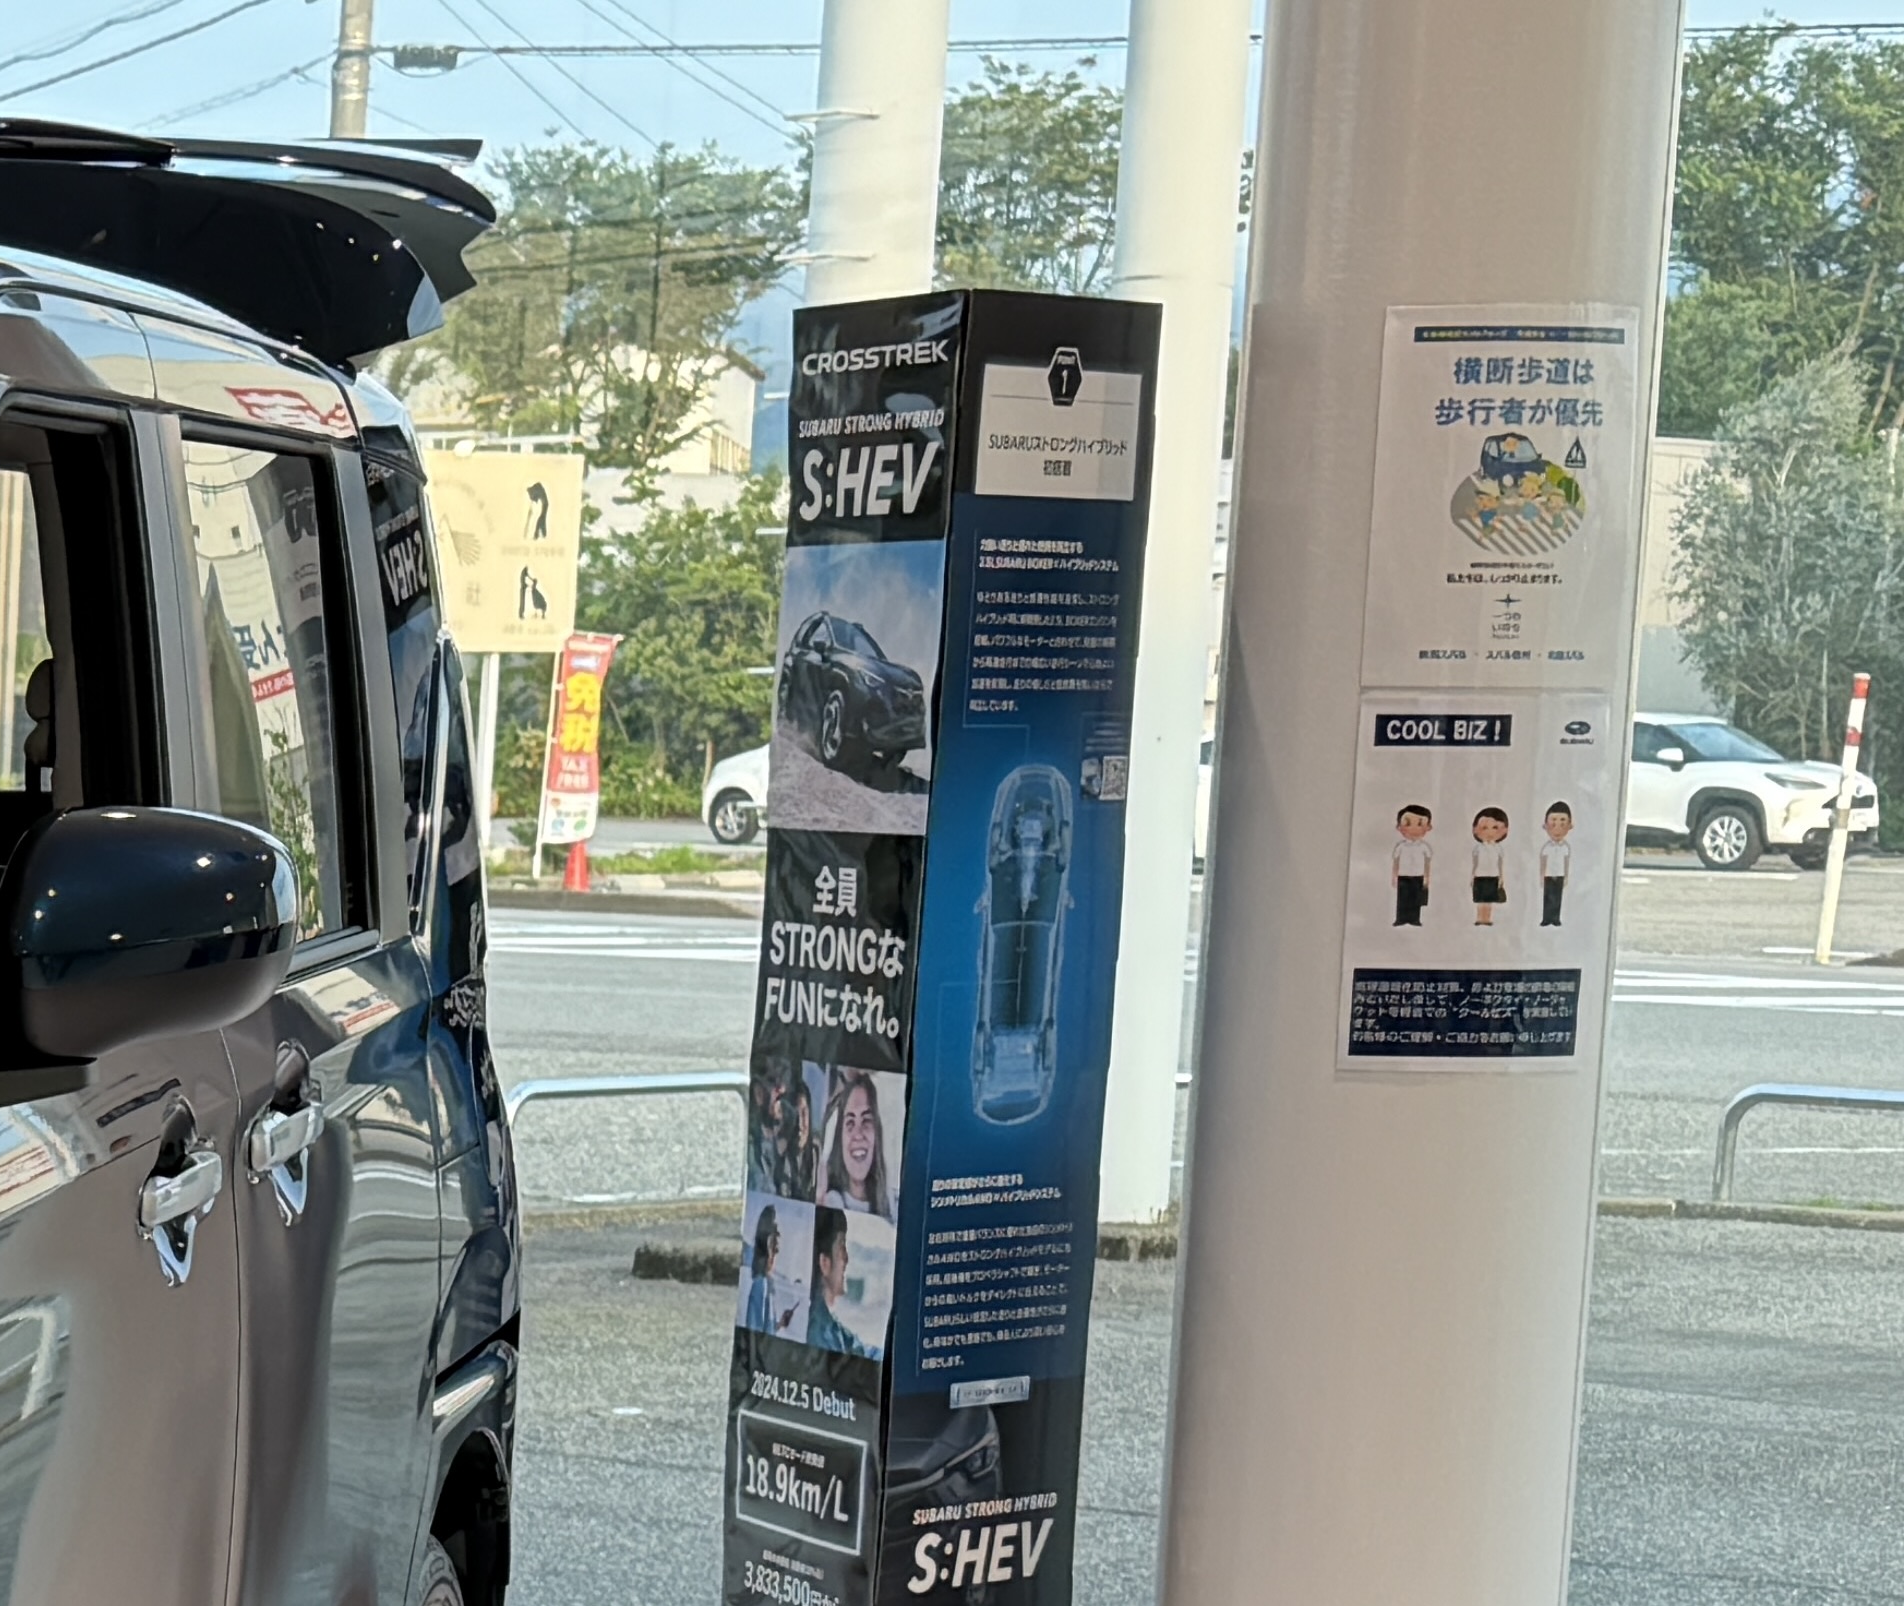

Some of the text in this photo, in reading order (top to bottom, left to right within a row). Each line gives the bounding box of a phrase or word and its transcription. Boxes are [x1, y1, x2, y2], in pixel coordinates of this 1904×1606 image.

[802, 340, 949, 377] CROSSTREK
[1454, 356, 1595, 385] 横断歩道は
[798, 408, 945, 438] SUBARU STRONG HYBRID
[1435, 397, 1603, 427] 歩行者が優先
[799, 441, 940, 522] S:HEV
[1386, 720, 1446, 741] COOL
[1453, 720, 1488, 741] BIZ
[812, 865, 857, 917] 全員
[769, 921, 907, 978] STRONGな
[763, 976, 901, 1040] FUNになれ。
[751, 1369, 857, 1423] 2024.12.5 Debut
[744, 1454, 849, 1524] 18.9km/L
[912, 1491, 1058, 1526] SUBARU STRONG HYBRID
[907, 1517, 1054, 1597] S:HEV
